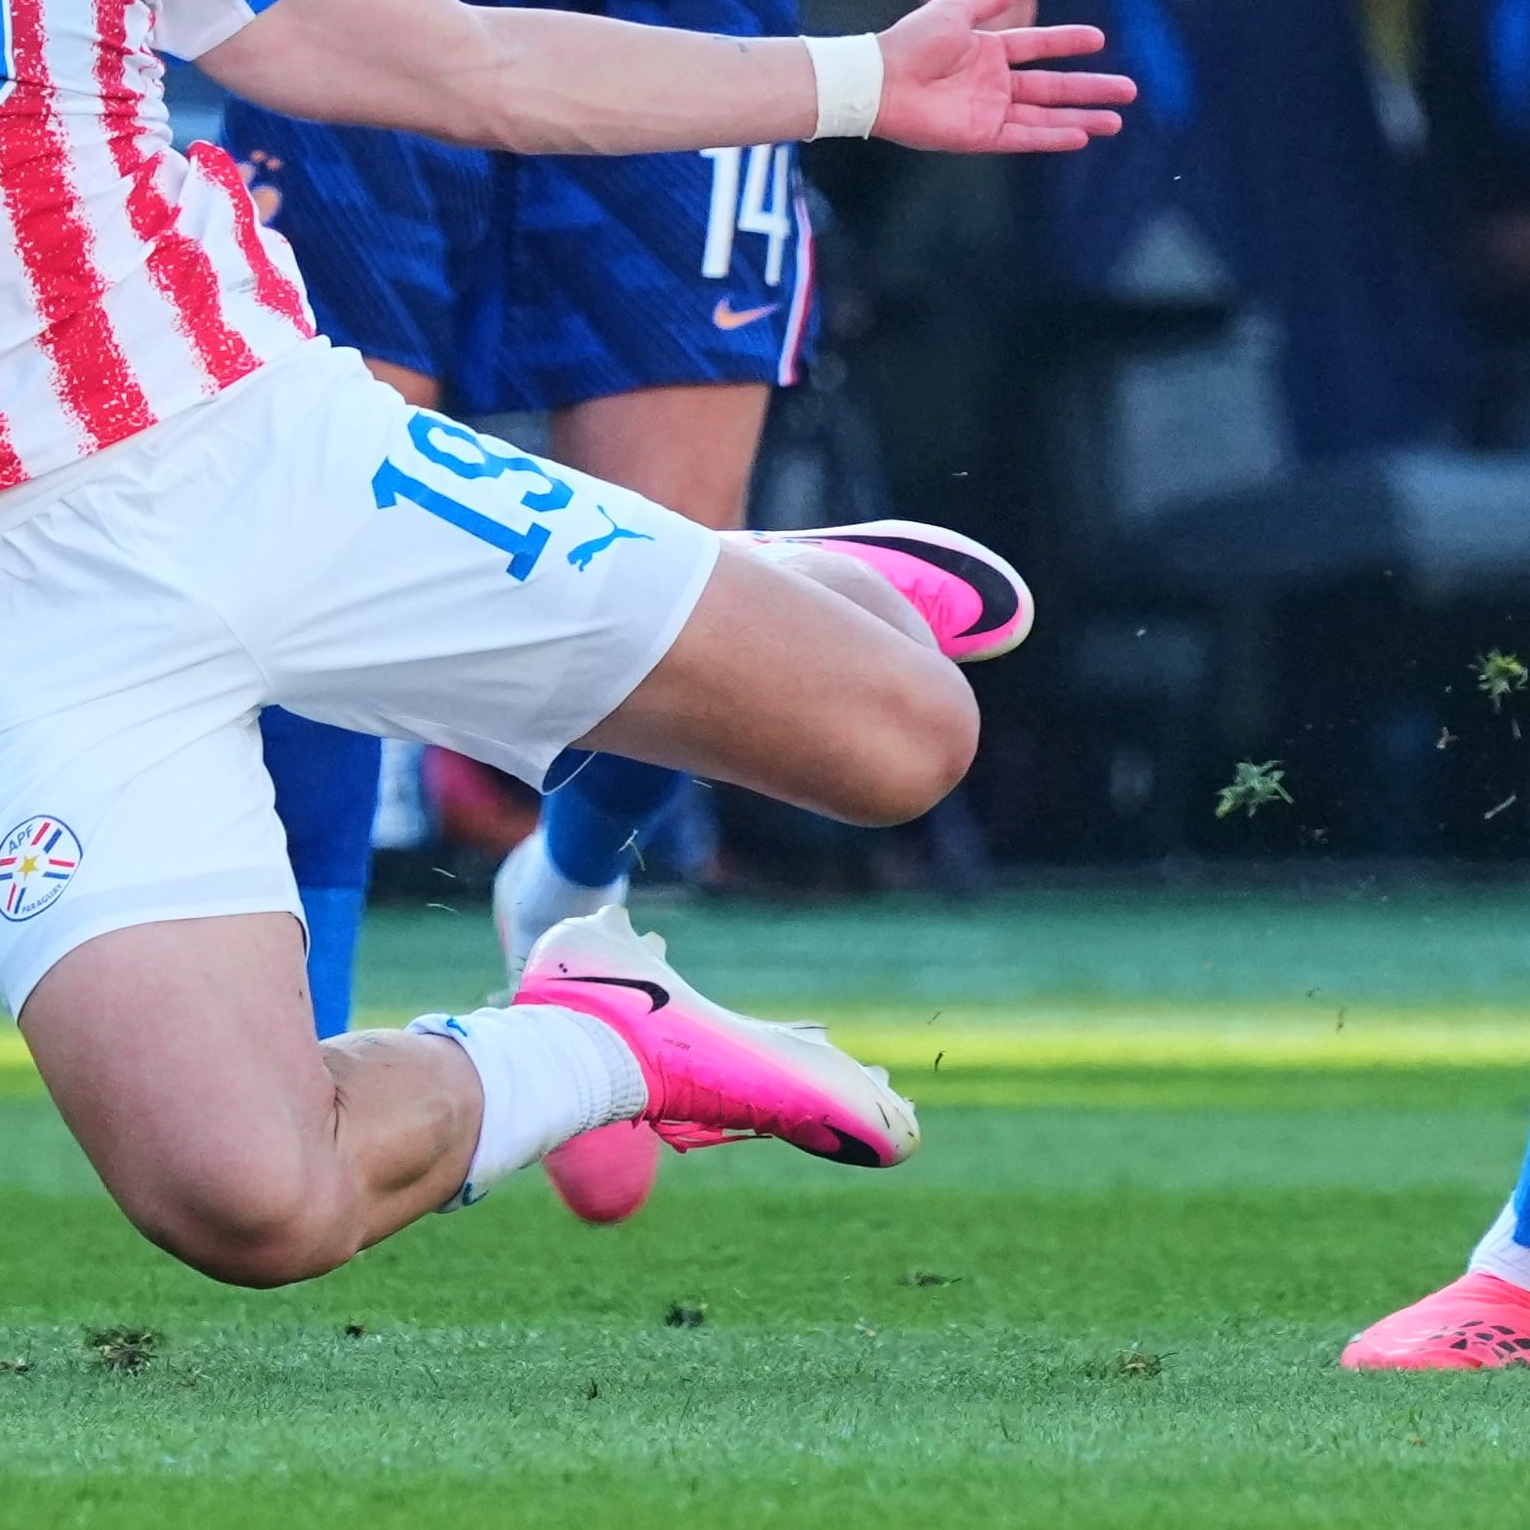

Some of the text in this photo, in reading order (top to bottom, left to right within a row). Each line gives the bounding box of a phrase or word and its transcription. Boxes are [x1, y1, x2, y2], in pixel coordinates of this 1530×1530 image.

[699, 144, 789, 286] 14
[370, 409, 576, 583] 19
[8, 823, 34, 855] APF
